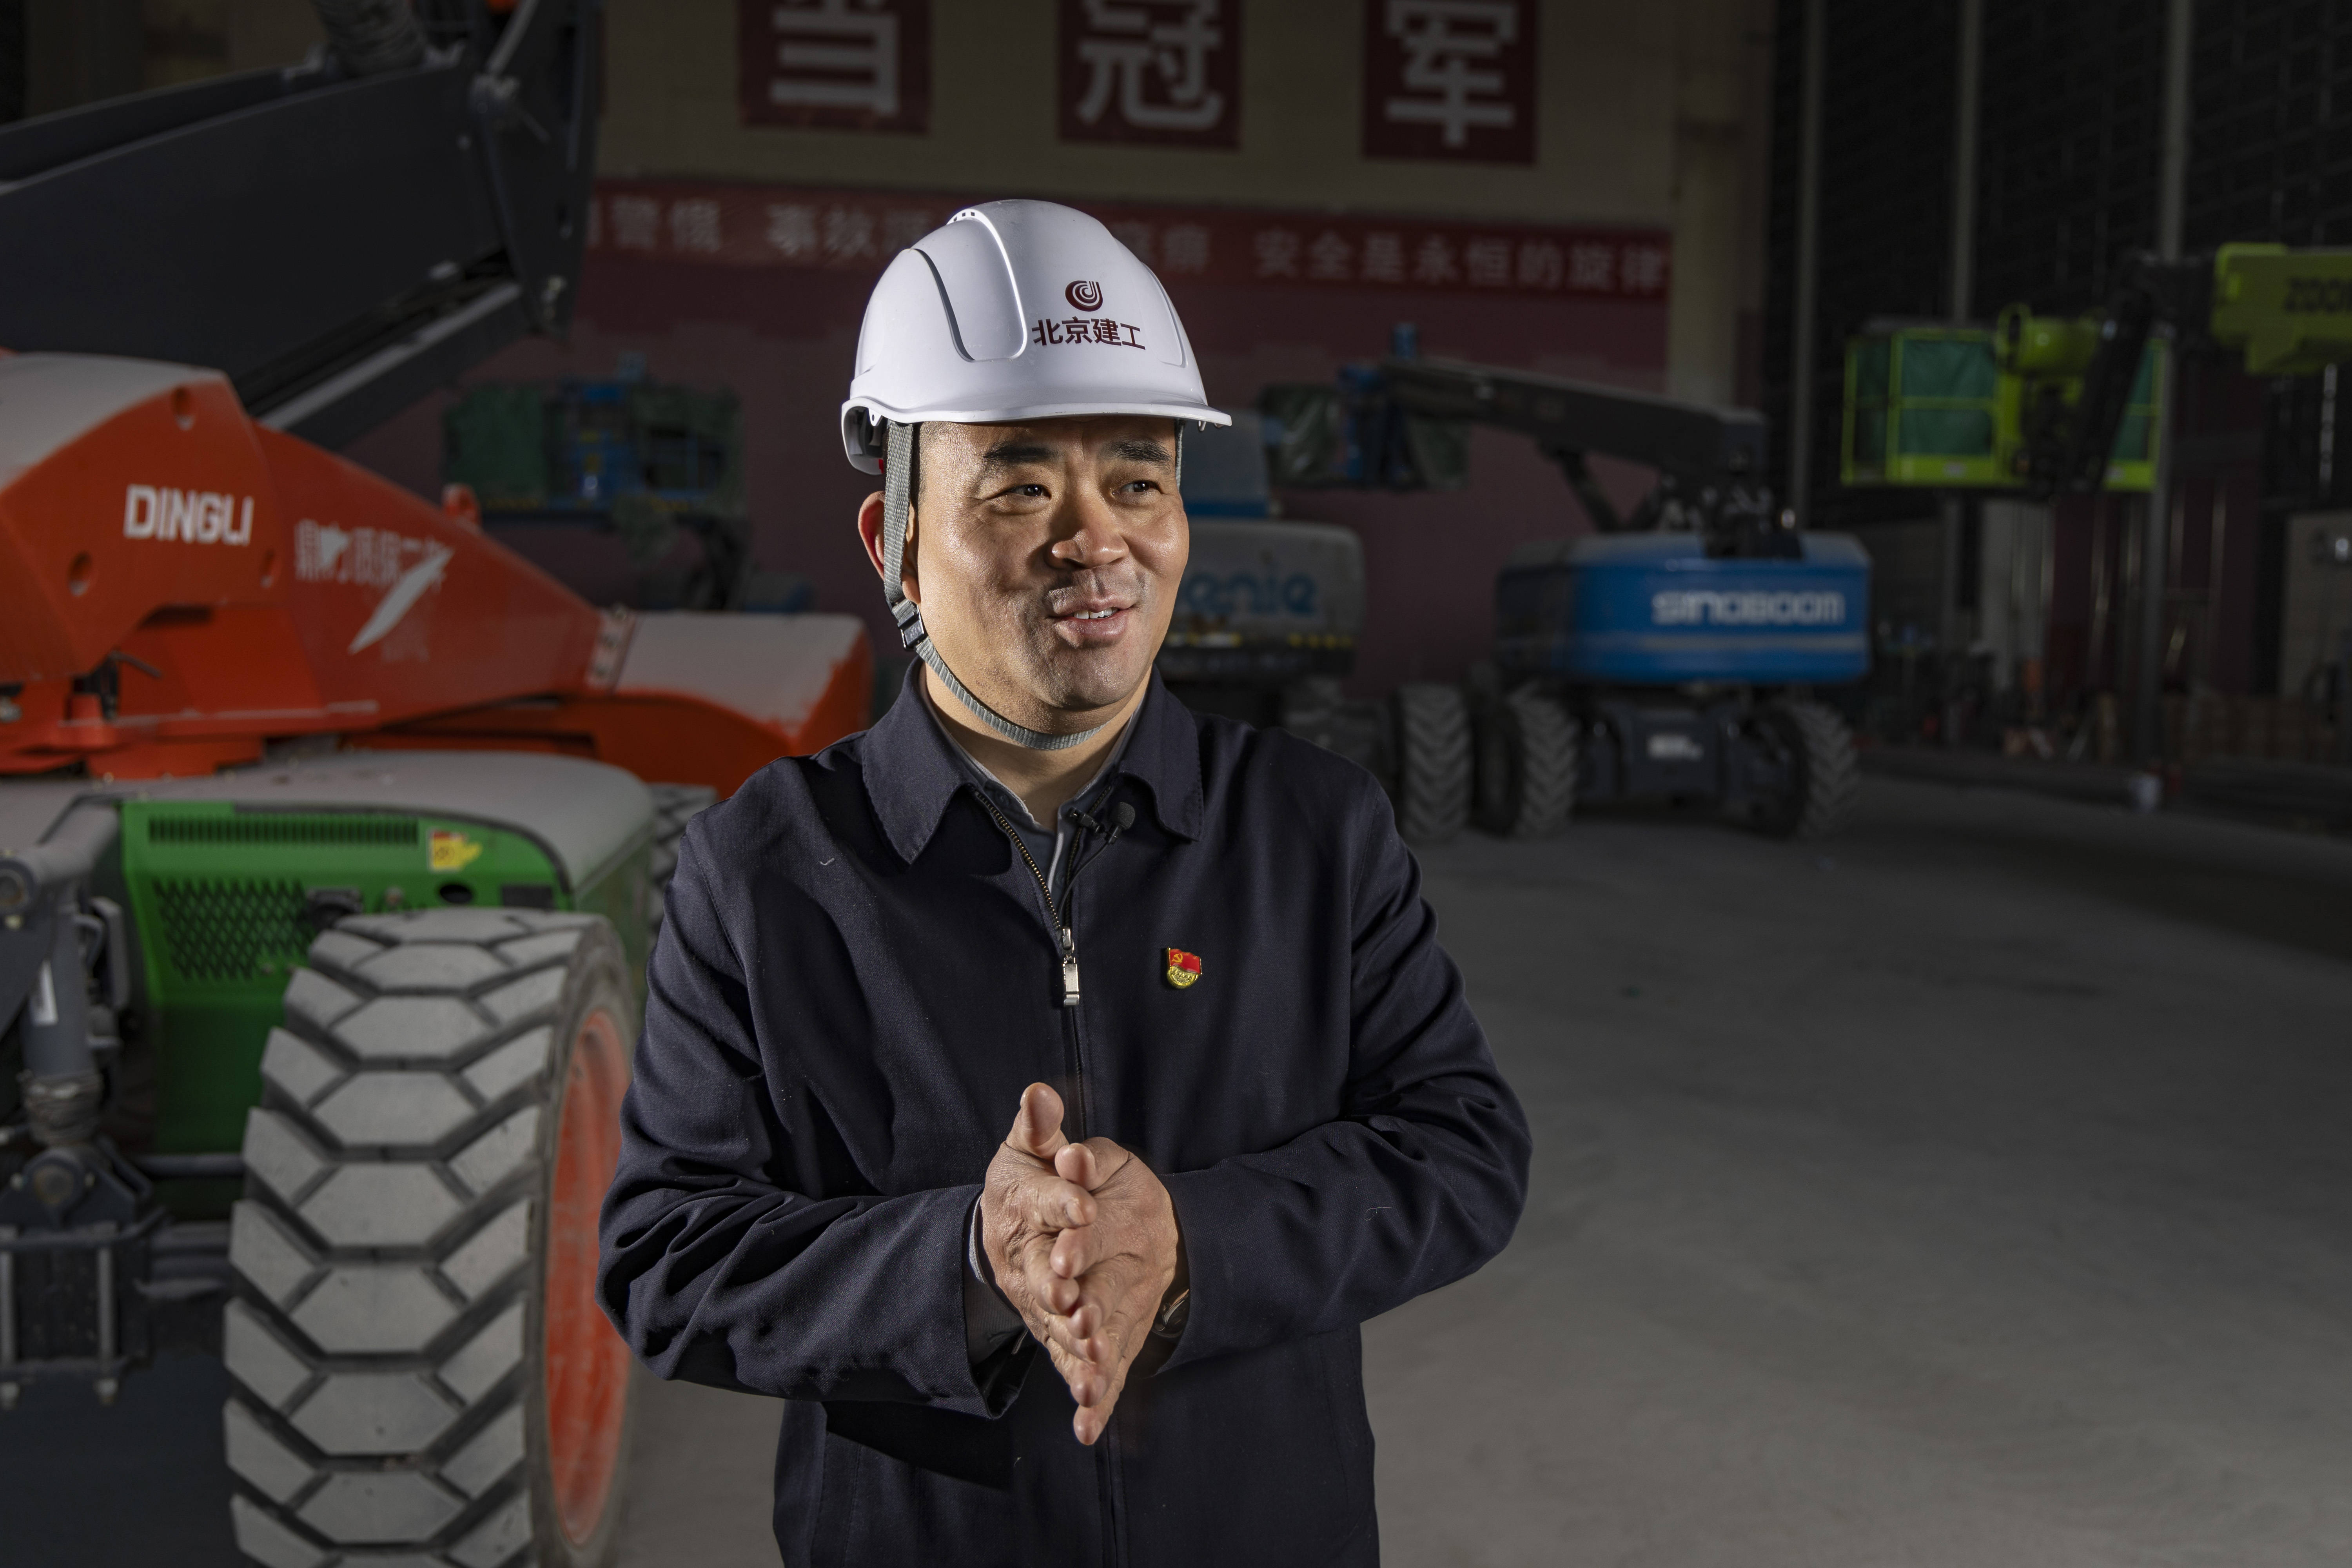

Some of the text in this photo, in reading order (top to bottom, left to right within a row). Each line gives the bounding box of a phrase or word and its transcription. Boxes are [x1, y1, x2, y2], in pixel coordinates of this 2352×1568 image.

[1253, 229, 1668, 293] 安全是永恒的旋律
[2283, 277, 2352, 314] ZOO
[1032, 316, 1146, 350] 北京建工
[123, 484, 256, 546] DINGLI
[1179, 572, 1318, 615] enie
